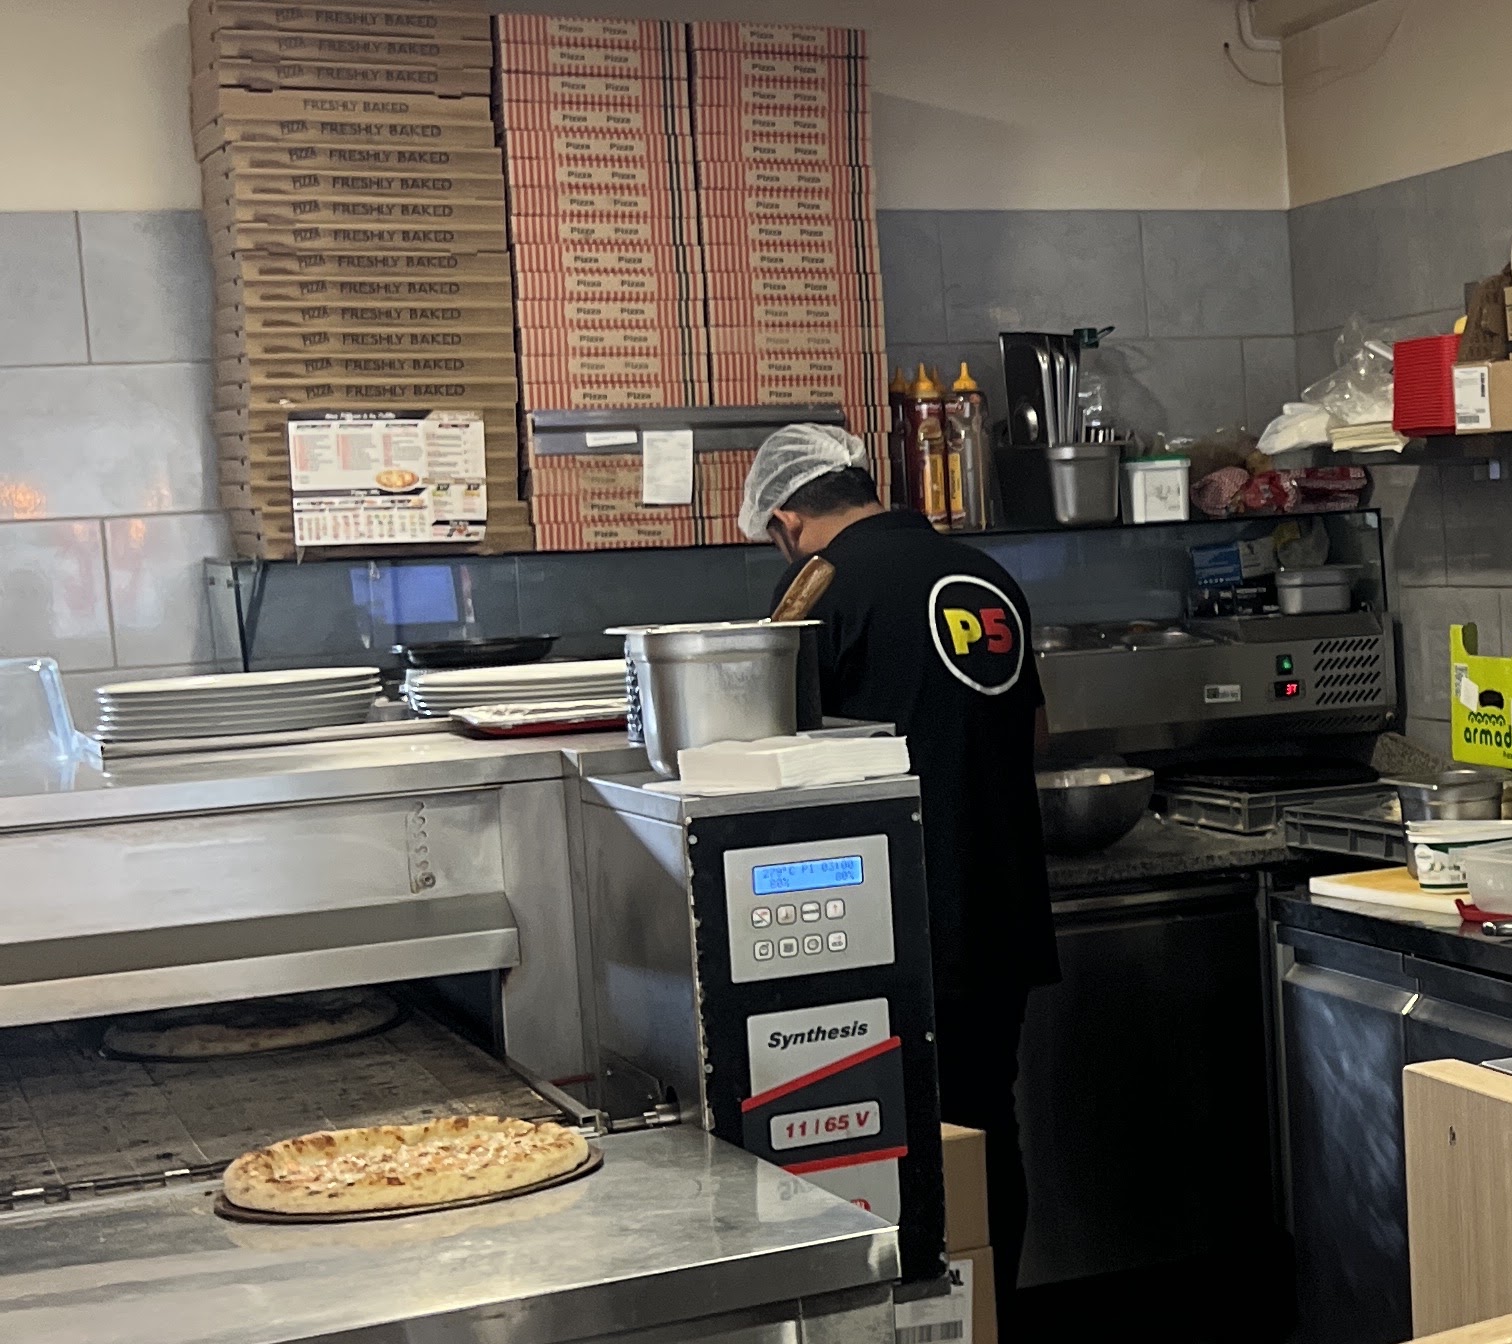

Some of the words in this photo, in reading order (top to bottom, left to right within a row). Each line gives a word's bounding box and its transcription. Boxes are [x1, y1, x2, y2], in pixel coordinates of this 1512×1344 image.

[303, 98, 357, 112] FRESHLY
[362, 101, 409, 113] BAKED
[329, 147, 394, 162] FRESHLY
[397, 151, 450, 164] BAKED
[574, 256, 599, 265] Pizza
[618, 256, 642, 265] Pizza
[340, 282, 400, 294] FRESHLY
[408, 282, 460, 294] BAKED
[345, 384, 406, 397] FRESHLY
[413, 384, 466, 397] BAKED
[943, 608, 1013, 655] P5
[767, 1021, 868, 1050] Synthesis
